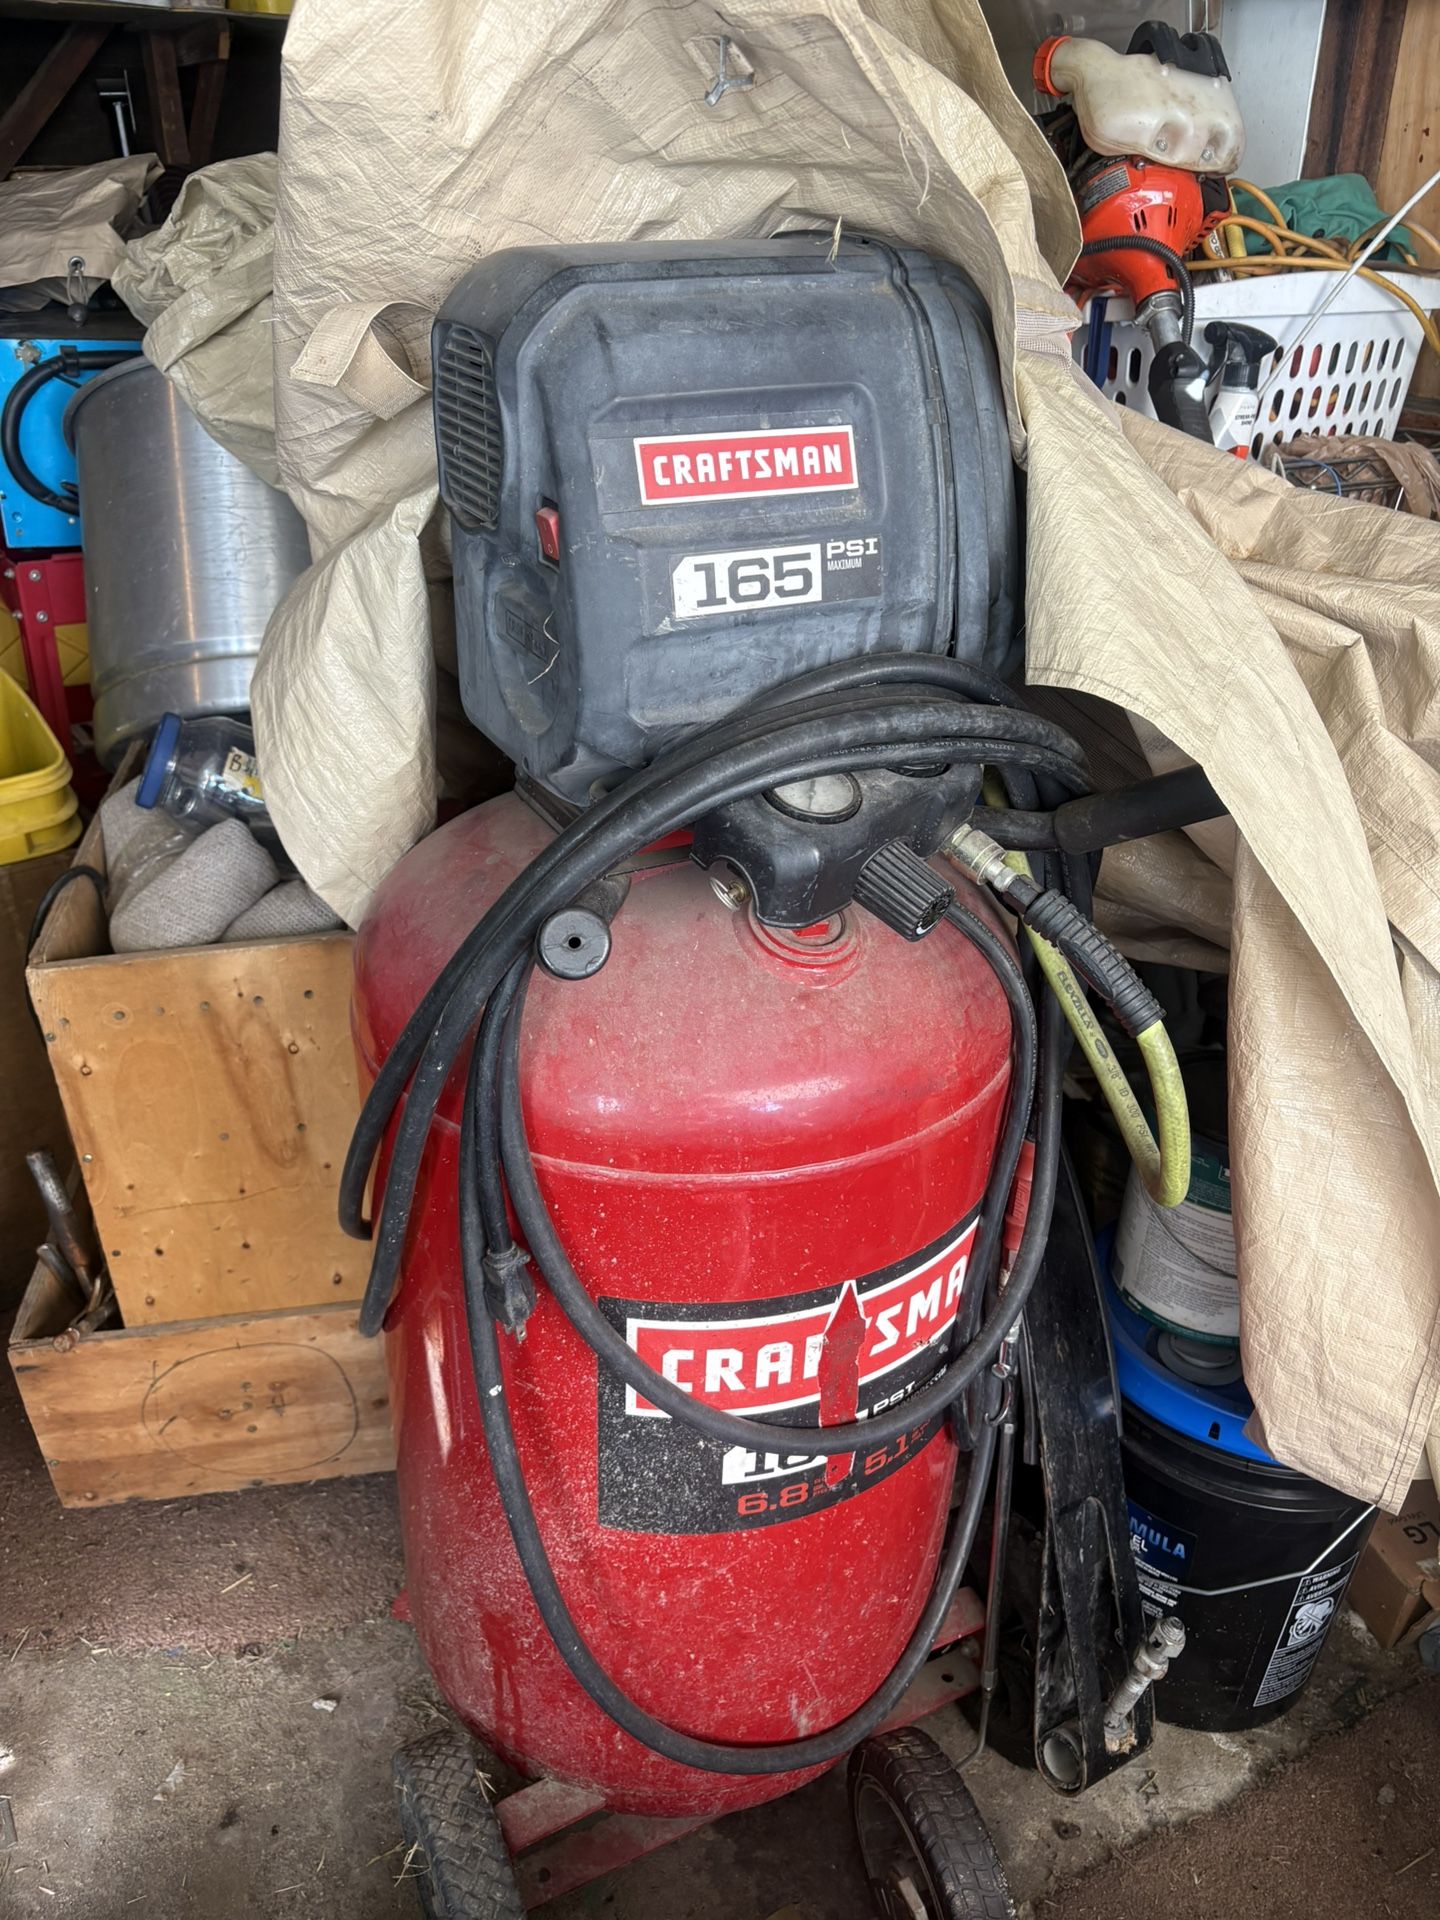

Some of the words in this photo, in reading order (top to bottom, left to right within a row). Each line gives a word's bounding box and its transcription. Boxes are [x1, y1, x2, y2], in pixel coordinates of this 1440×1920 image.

[653, 444, 843, 486] CRAFTSMAN
[693, 552, 813, 608] 165
[826, 537, 879, 559] PSI
[827, 557, 862, 572] MAXIMUM
[1057, 970, 1095, 1030] FLEXZILLA
[1126, 1102, 1141, 1120] 300
[661, 1254, 968, 1394] CRAFSMA
[737, 1481, 809, 1516] 6.8
[864, 1433, 909, 1476] 5.1
[1129, 1516, 1186, 1559] MULA
[1130, 1533, 1149, 1553] EL
